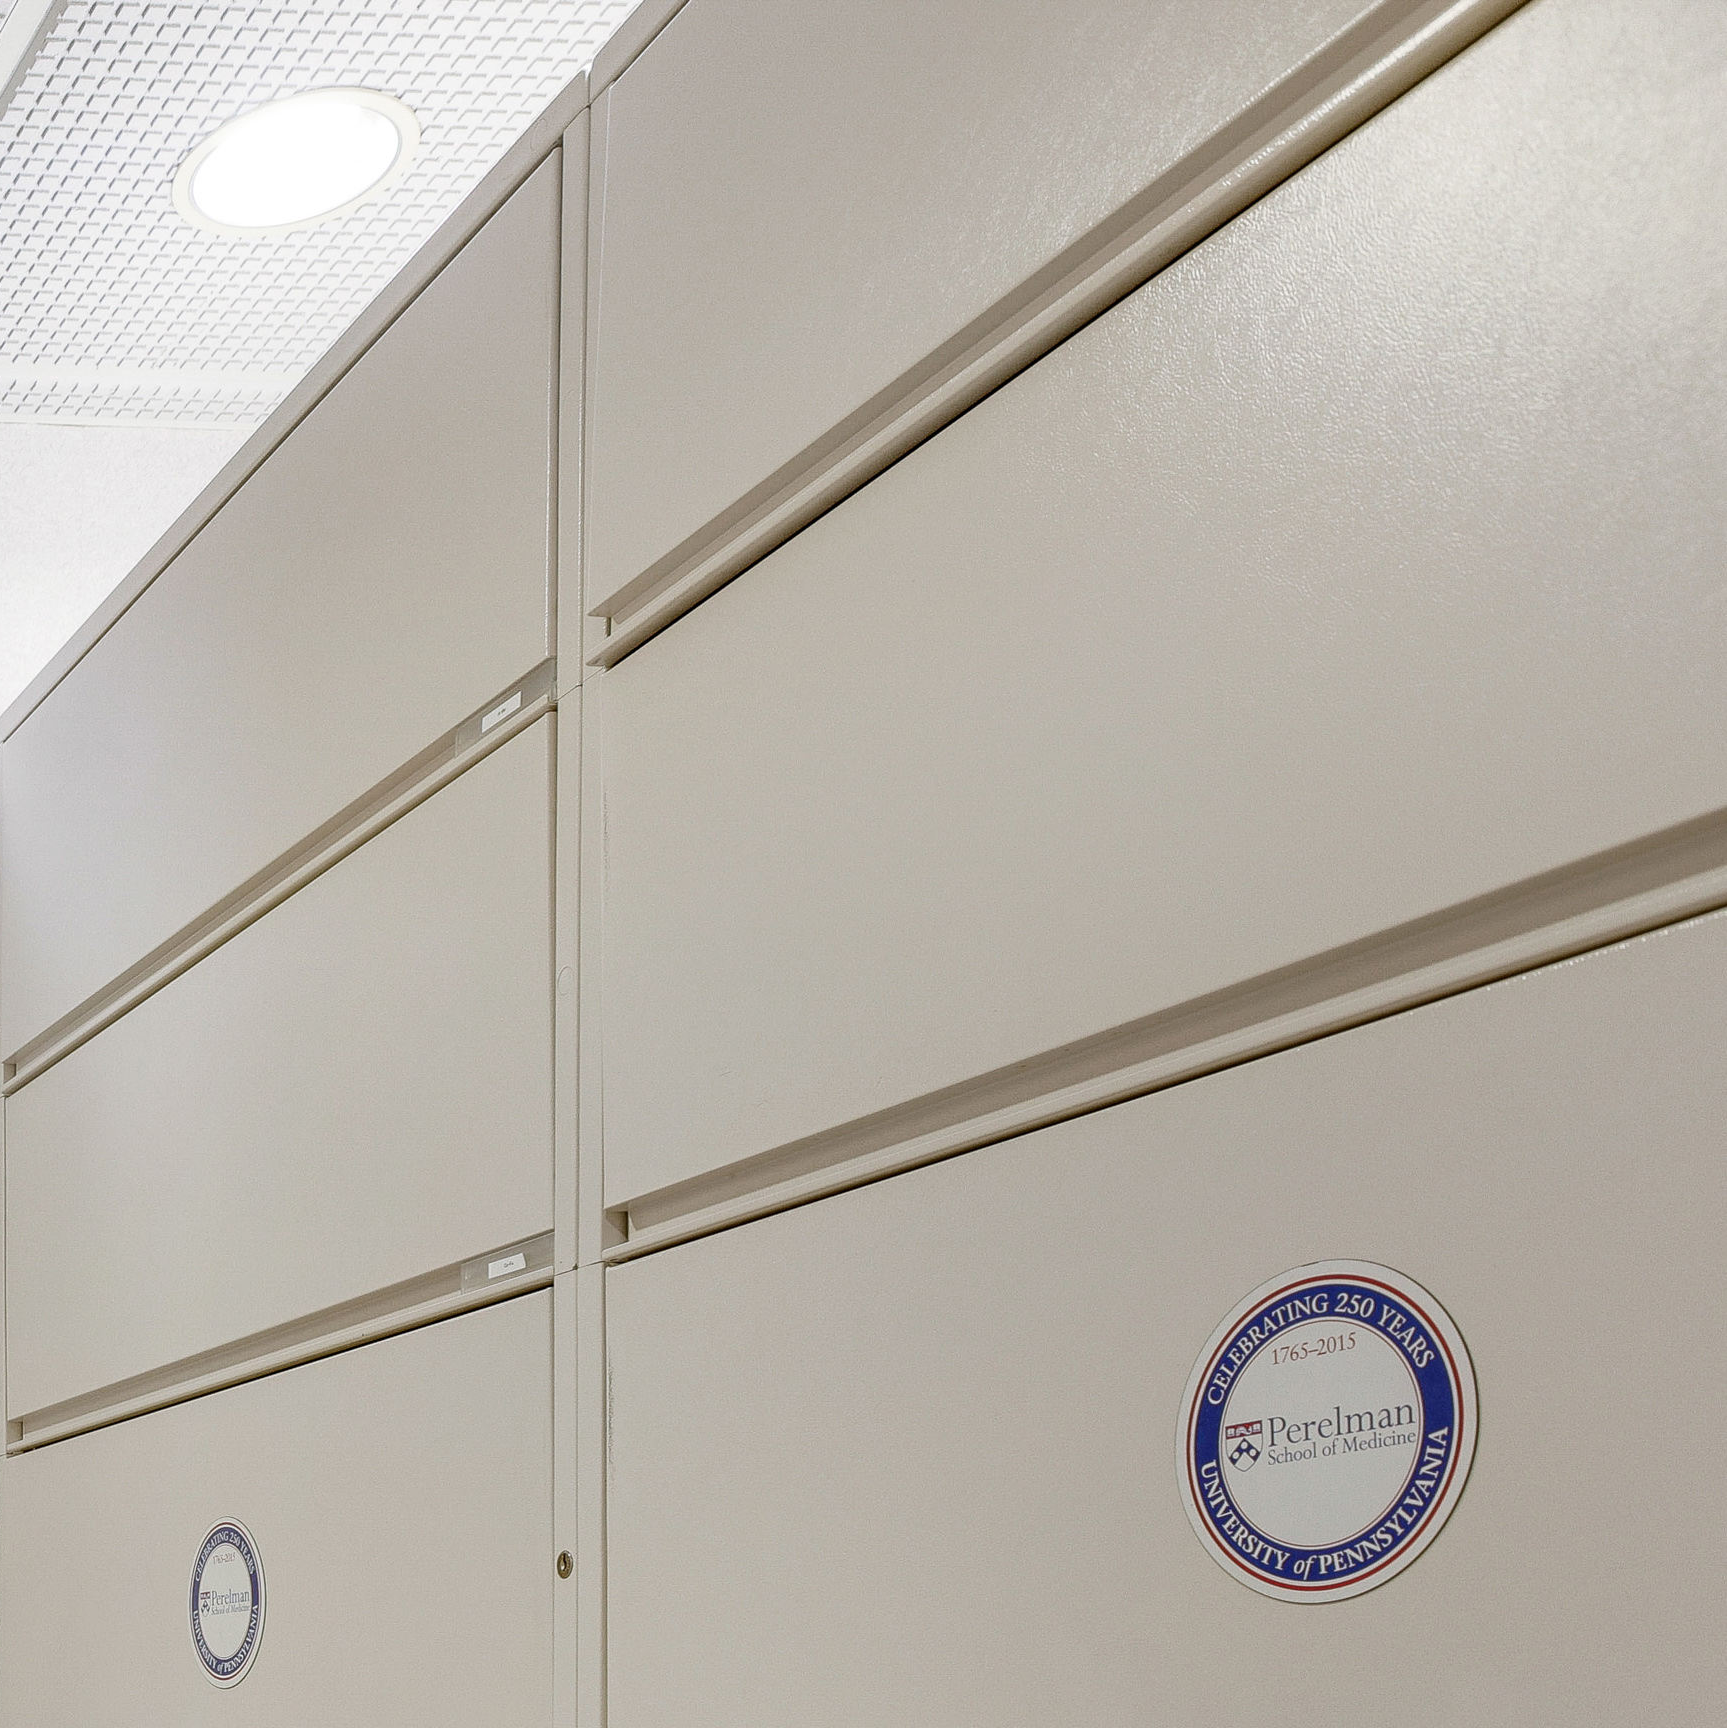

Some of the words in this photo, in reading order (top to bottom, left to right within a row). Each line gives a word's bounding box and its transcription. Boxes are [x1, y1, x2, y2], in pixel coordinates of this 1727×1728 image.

[1207, 1293, 1330, 1406] CELEBRATING
[1334, 1292, 1375, 1318] 250
[1375, 1304, 1435, 1369] YEARS
[1267, 1403, 1416, 1448] Perelman
[1267, 1442, 1318, 1466] School
[1322, 1438, 1340, 1458] of
[1342, 1428, 1417, 1455] Medicine
[1200, 1460, 1291, 1571] UNIVERSITY
[1293, 1555, 1316, 1581] of
[1318, 1426, 1450, 1575] PENNSYLVANIA
[195, 1530, 229, 1582] CELEBRATING
[230, 1532, 241, 1546] 250
[240, 1541, 256, 1575] YEARS
[211, 1589, 250, 1606] Perelman
[211, 1606, 226, 1616] School
[231, 1603, 250, 1614] Medicine
[193, 1610, 217, 1669] UNIVERSITY
[223, 1605, 259, 1673] PENNSYLVANIA
